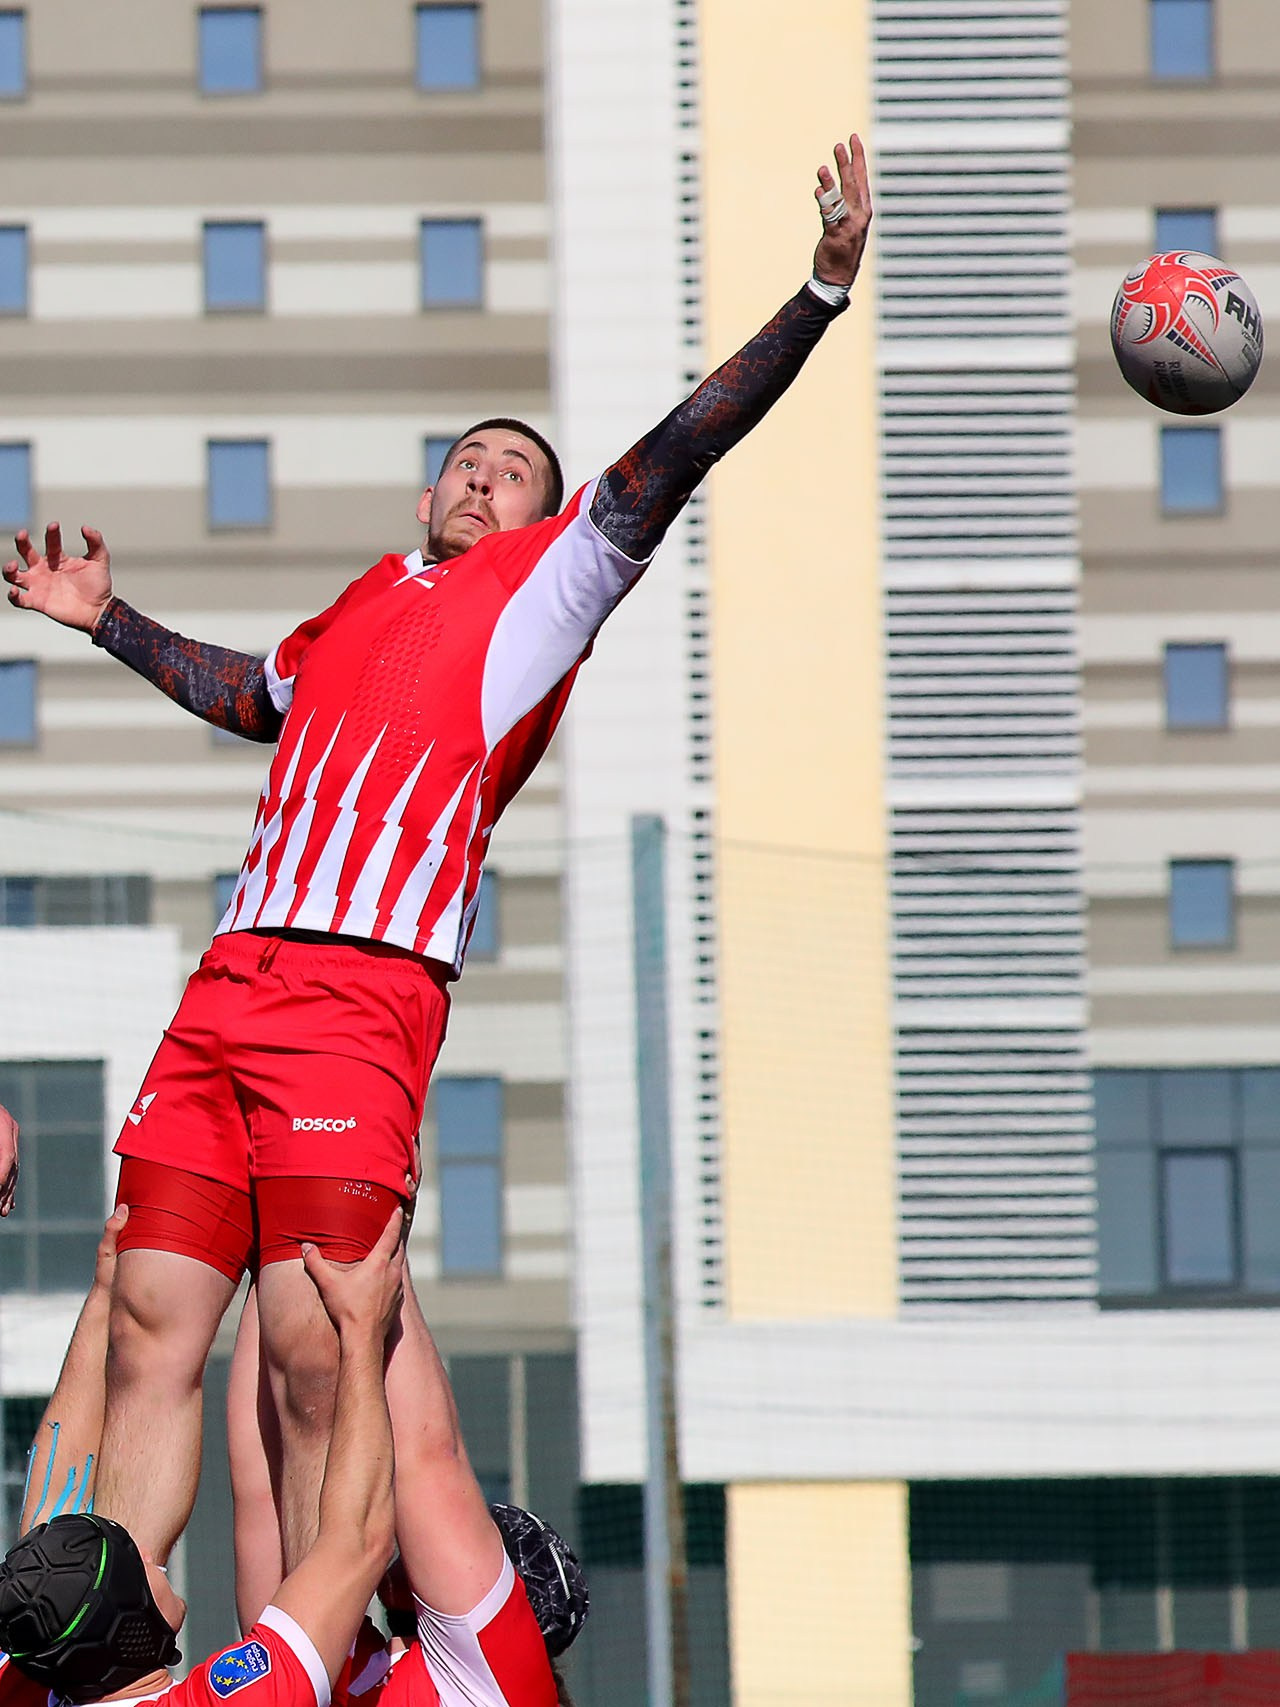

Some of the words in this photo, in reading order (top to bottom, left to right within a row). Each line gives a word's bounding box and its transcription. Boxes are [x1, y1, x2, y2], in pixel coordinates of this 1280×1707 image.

[292, 1117, 347, 1133] BOSCO
[244, 1649, 259, 1672] rugby
[251, 1644, 267, 1671] europe
